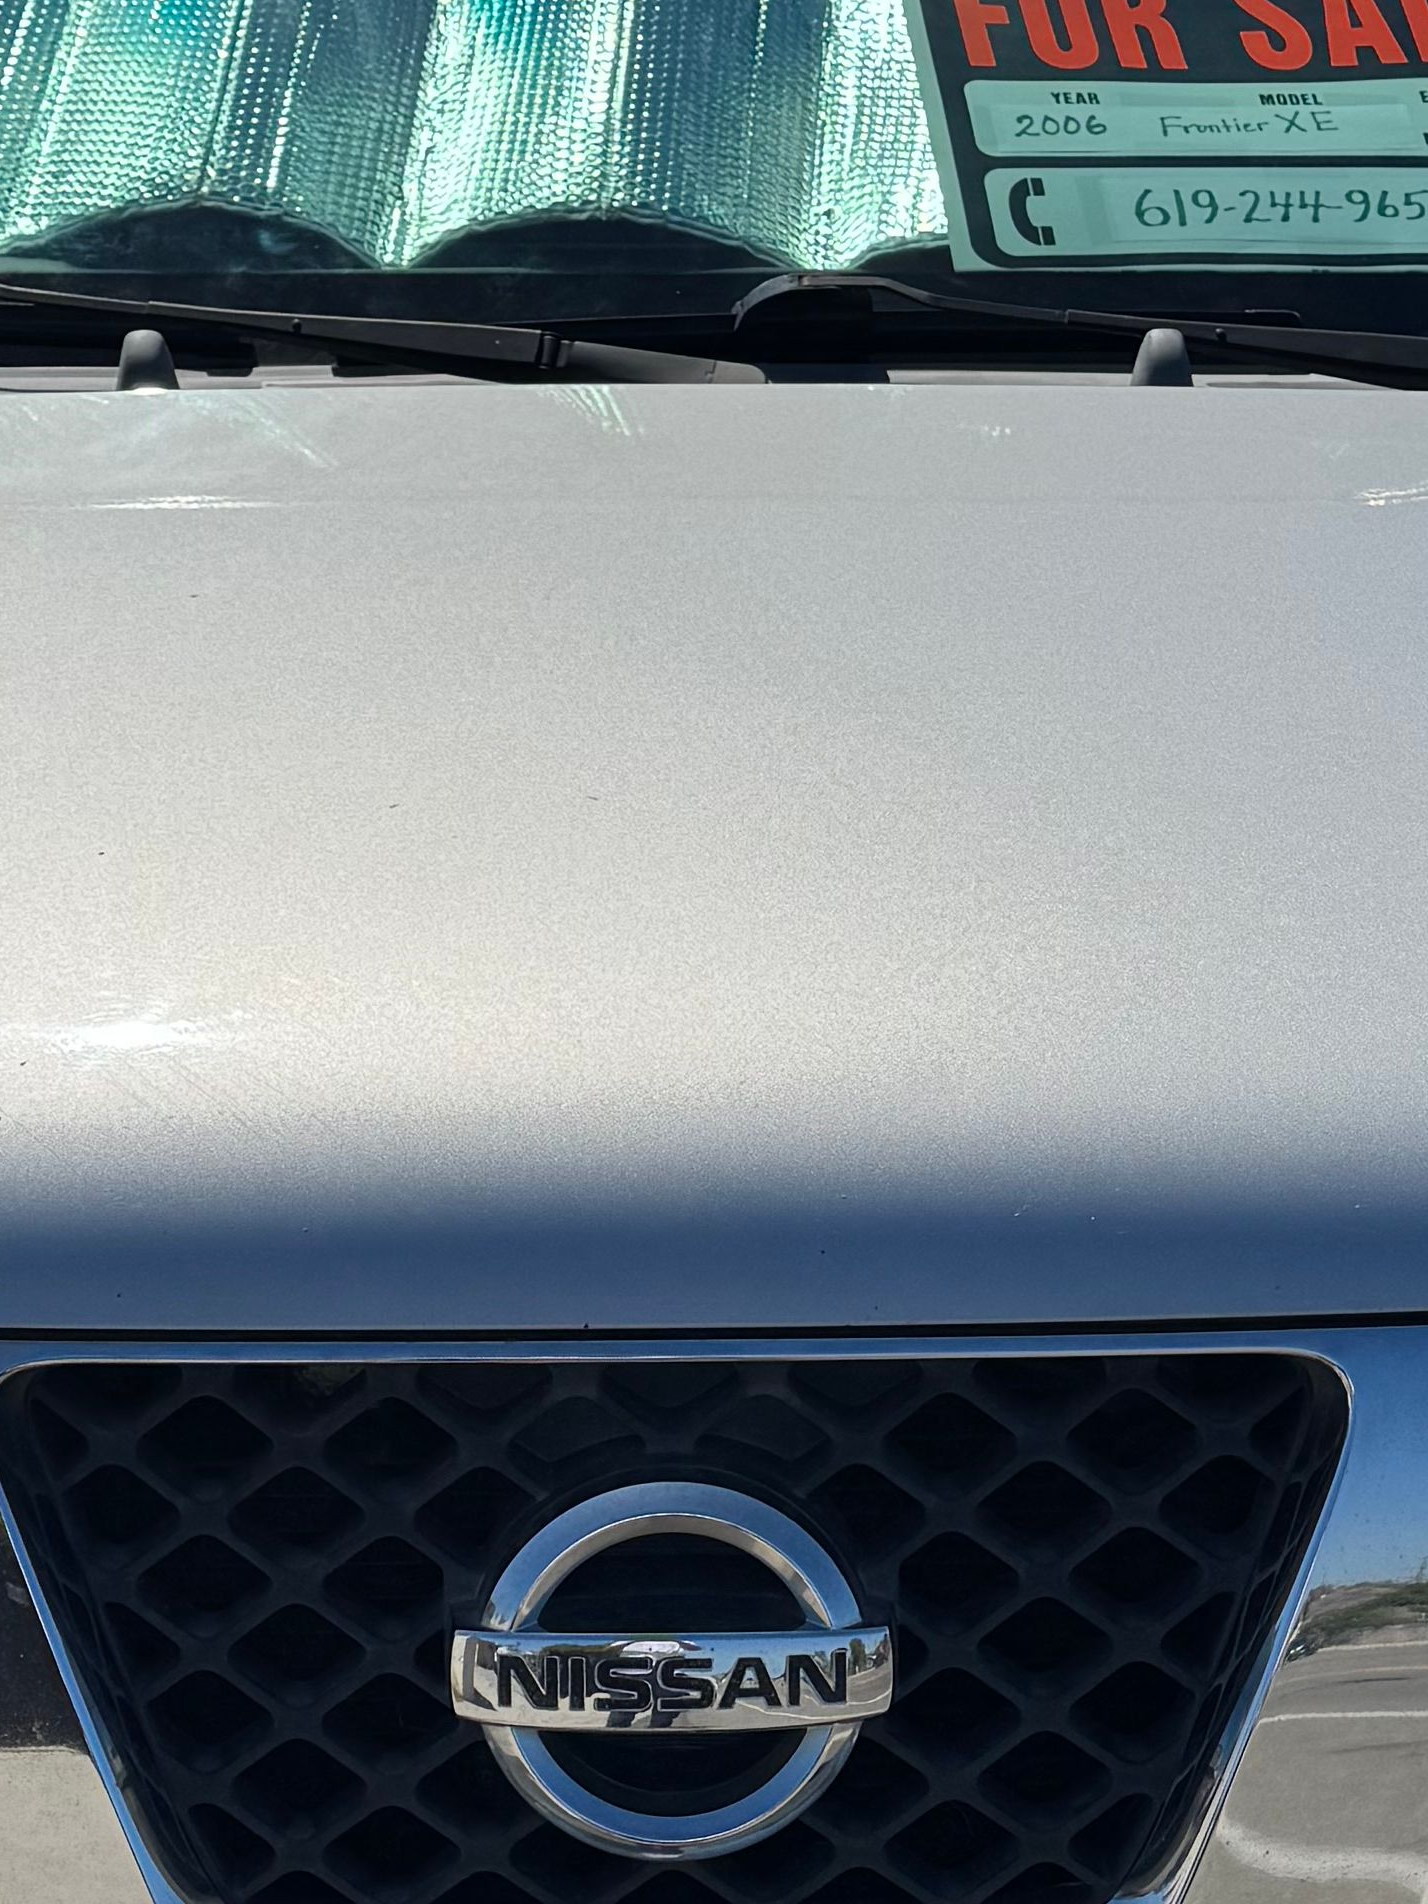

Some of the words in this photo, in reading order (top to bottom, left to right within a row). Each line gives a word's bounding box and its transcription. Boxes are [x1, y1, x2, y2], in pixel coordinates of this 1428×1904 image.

[1050, 92, 1101, 105] YEAR
[1258, 93, 1324, 107] MODEL
[1014, 115, 1108, 138] 2006
[1160, 115, 1270, 138] Frontier
[1274, 110, 1339, 134] XE
[497, 1648, 848, 1712] NISSAN
